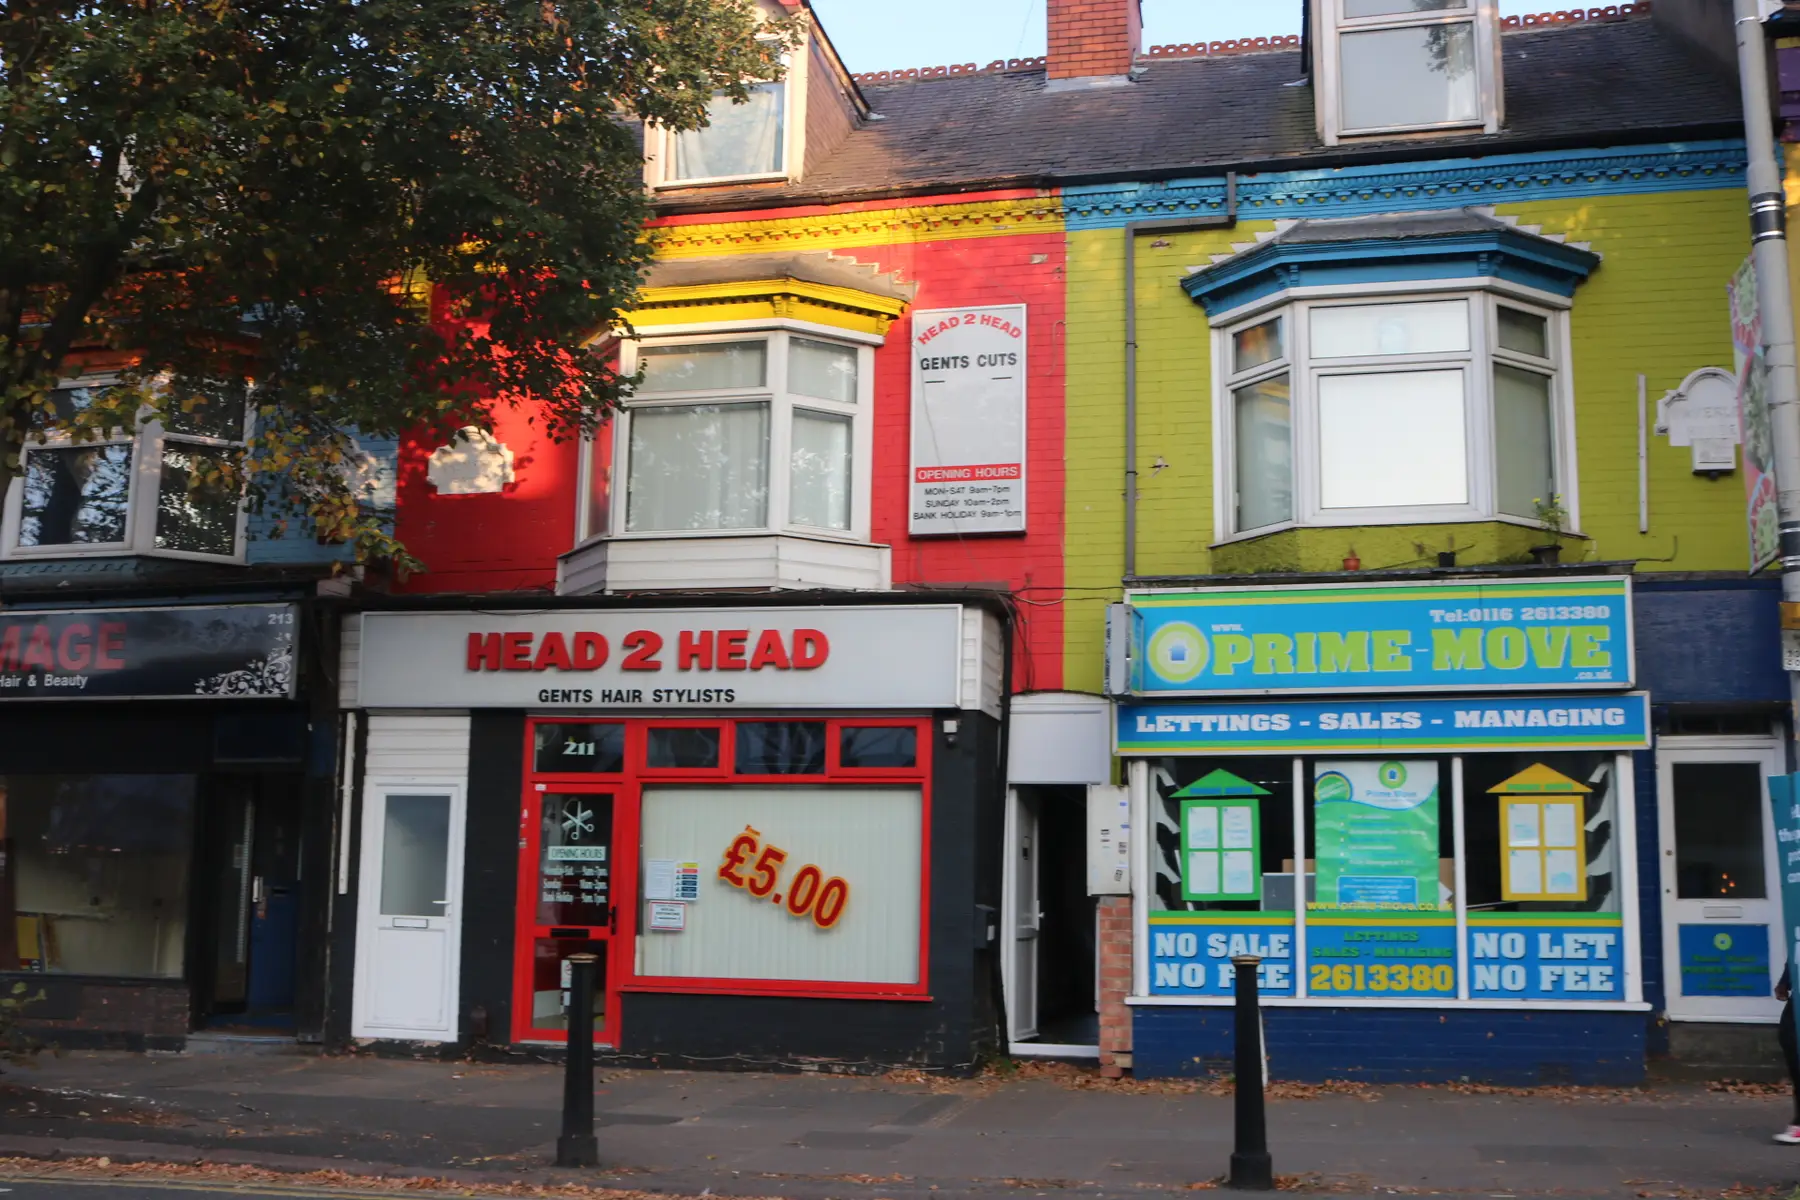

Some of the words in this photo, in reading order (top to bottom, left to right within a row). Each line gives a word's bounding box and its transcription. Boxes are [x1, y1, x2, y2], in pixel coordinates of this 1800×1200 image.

[917, 316, 960, 345] HEAD
[963, 313, 976, 325] 2
[979, 314, 1022, 338] HEAD
[920, 355, 969, 370] GENTS
[977, 352, 1017, 367] CUTS
[917, 468, 971, 480] OPENING
[975, 466, 1018, 477] HOURS
[924, 486, 965, 496] MON-SAT
[925, 499, 960, 508] SUNDAY
[913, 512, 937, 520] BANK
[940, 510, 976, 519] HOLIDAY
[267, 613, 294, 625] 213
[1520, 605, 1611, 621] 2613380
[1211, 623, 1244, 632] www.
[466, 631, 610, 672] HEAD
[621, 629, 664, 671] 2
[678, 628, 830, 671] HEAD
[27, 674, 37, 687] &
[44, 673, 88, 689] Beauty
[538, 689, 593, 703] GENTS
[601, 689, 642, 703] HAIR
[652, 688, 735, 703] STYLISTS
[1136, 714, 1290, 733] LETTINGS
[1319, 712, 1422, 730] SALES
[1454, 708, 1625, 728] MANAGING
[562, 741, 596, 756] 211
[717, 832, 849, 930] £5.00
[1344, 931, 1420, 942] LETTINGS
[1154, 932, 1198, 957] NO
[1207, 932, 1290, 958] SALE
[1311, 946, 1360, 958] SALES
[1374, 947, 1453, 958] MANAGING
[1472, 932, 1527, 959] NO
[1537, 933, 1616, 959] LET
[1154, 963, 1206, 988] NO
[1310, 964, 1455, 992] 2613380
[1473, 965, 1527, 991] NO
[1538, 965, 1615, 992] FEE
